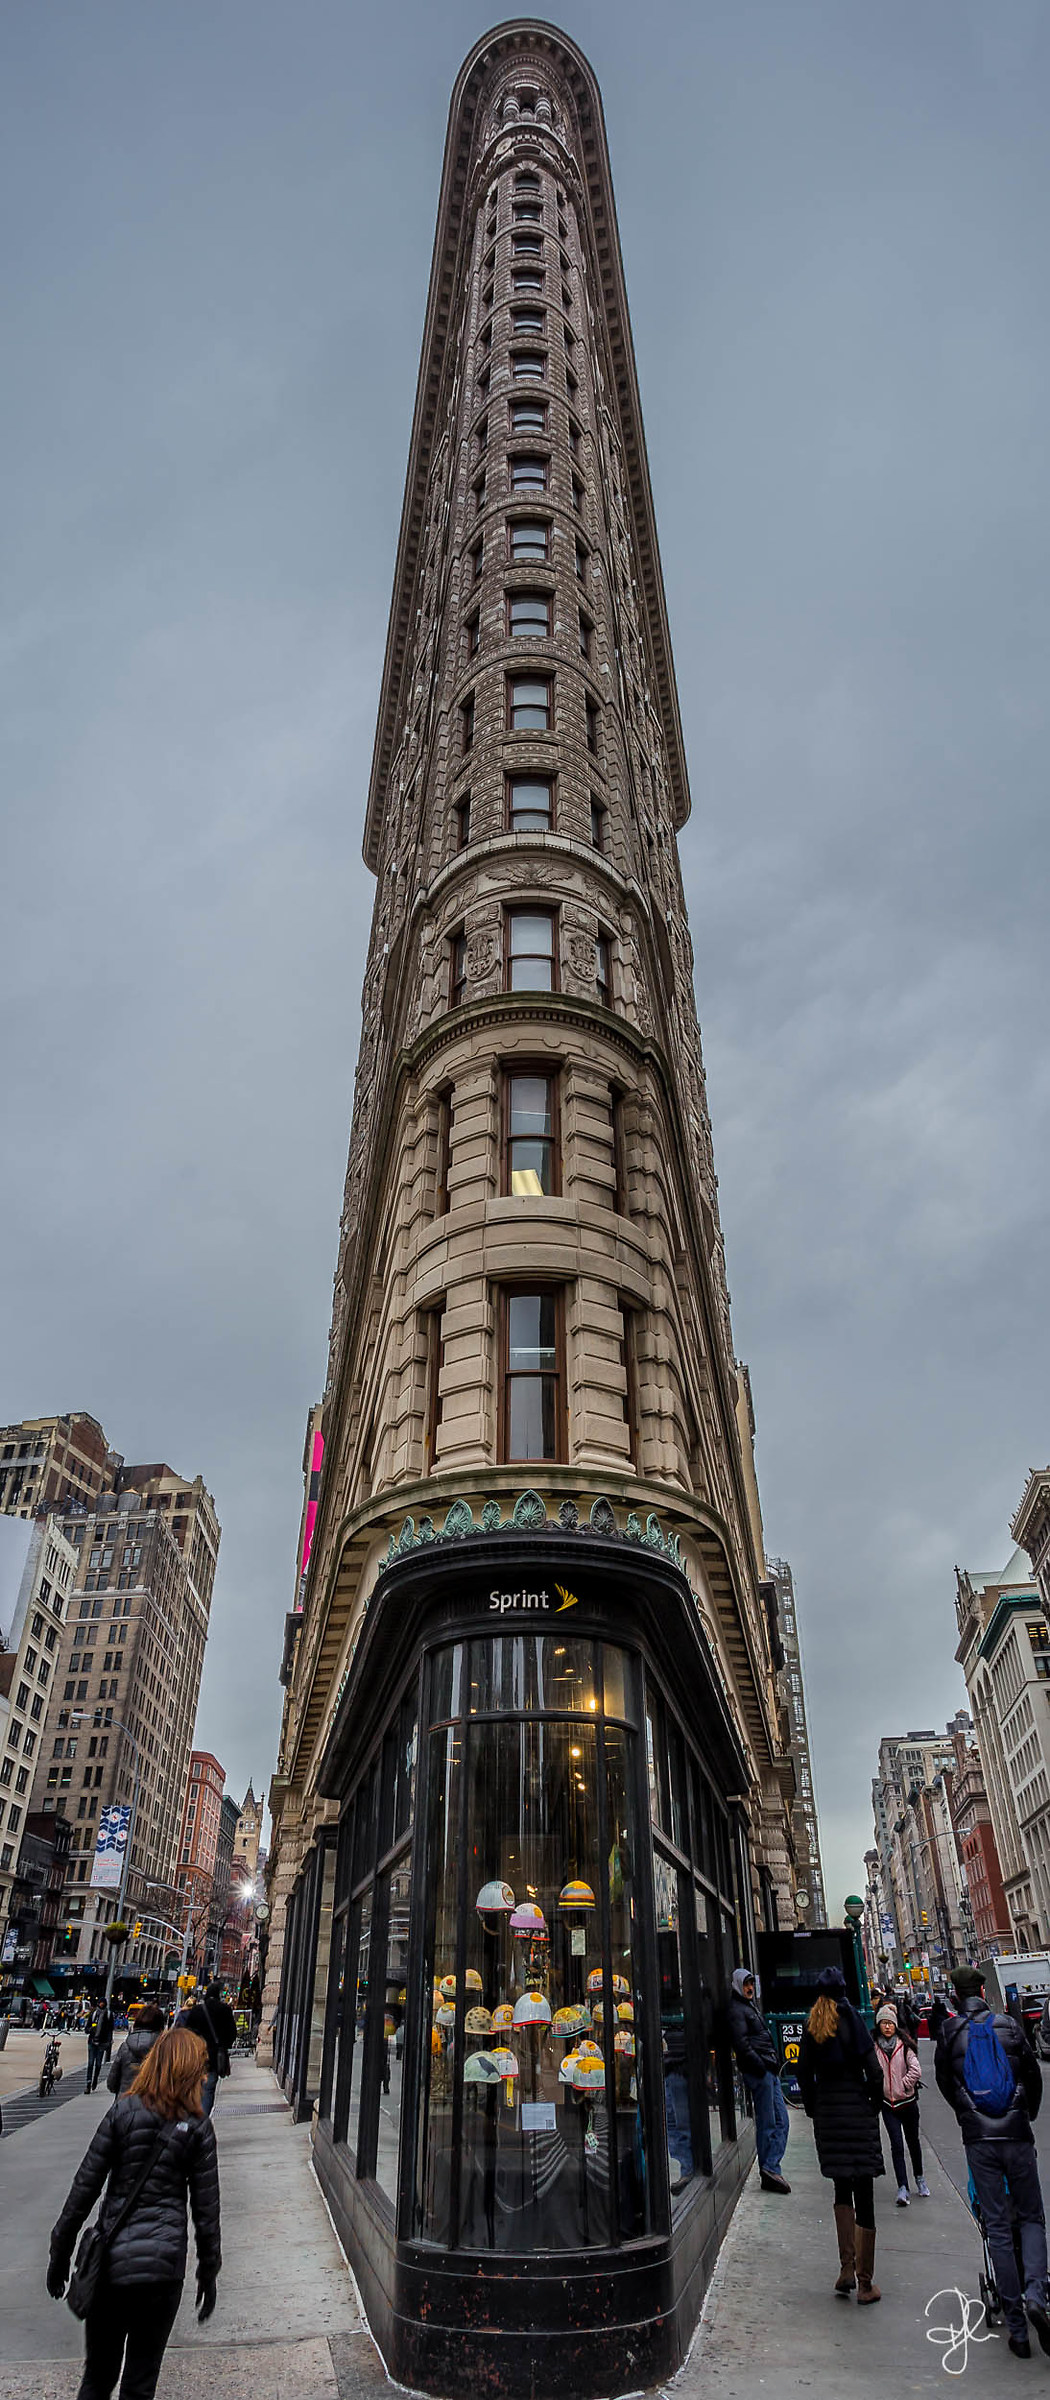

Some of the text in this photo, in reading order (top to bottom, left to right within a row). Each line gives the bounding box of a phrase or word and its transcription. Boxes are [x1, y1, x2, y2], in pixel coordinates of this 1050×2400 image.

[489, 1589, 550, 1614] Sprint
[782, 2024, 803, 2035] 23 S
